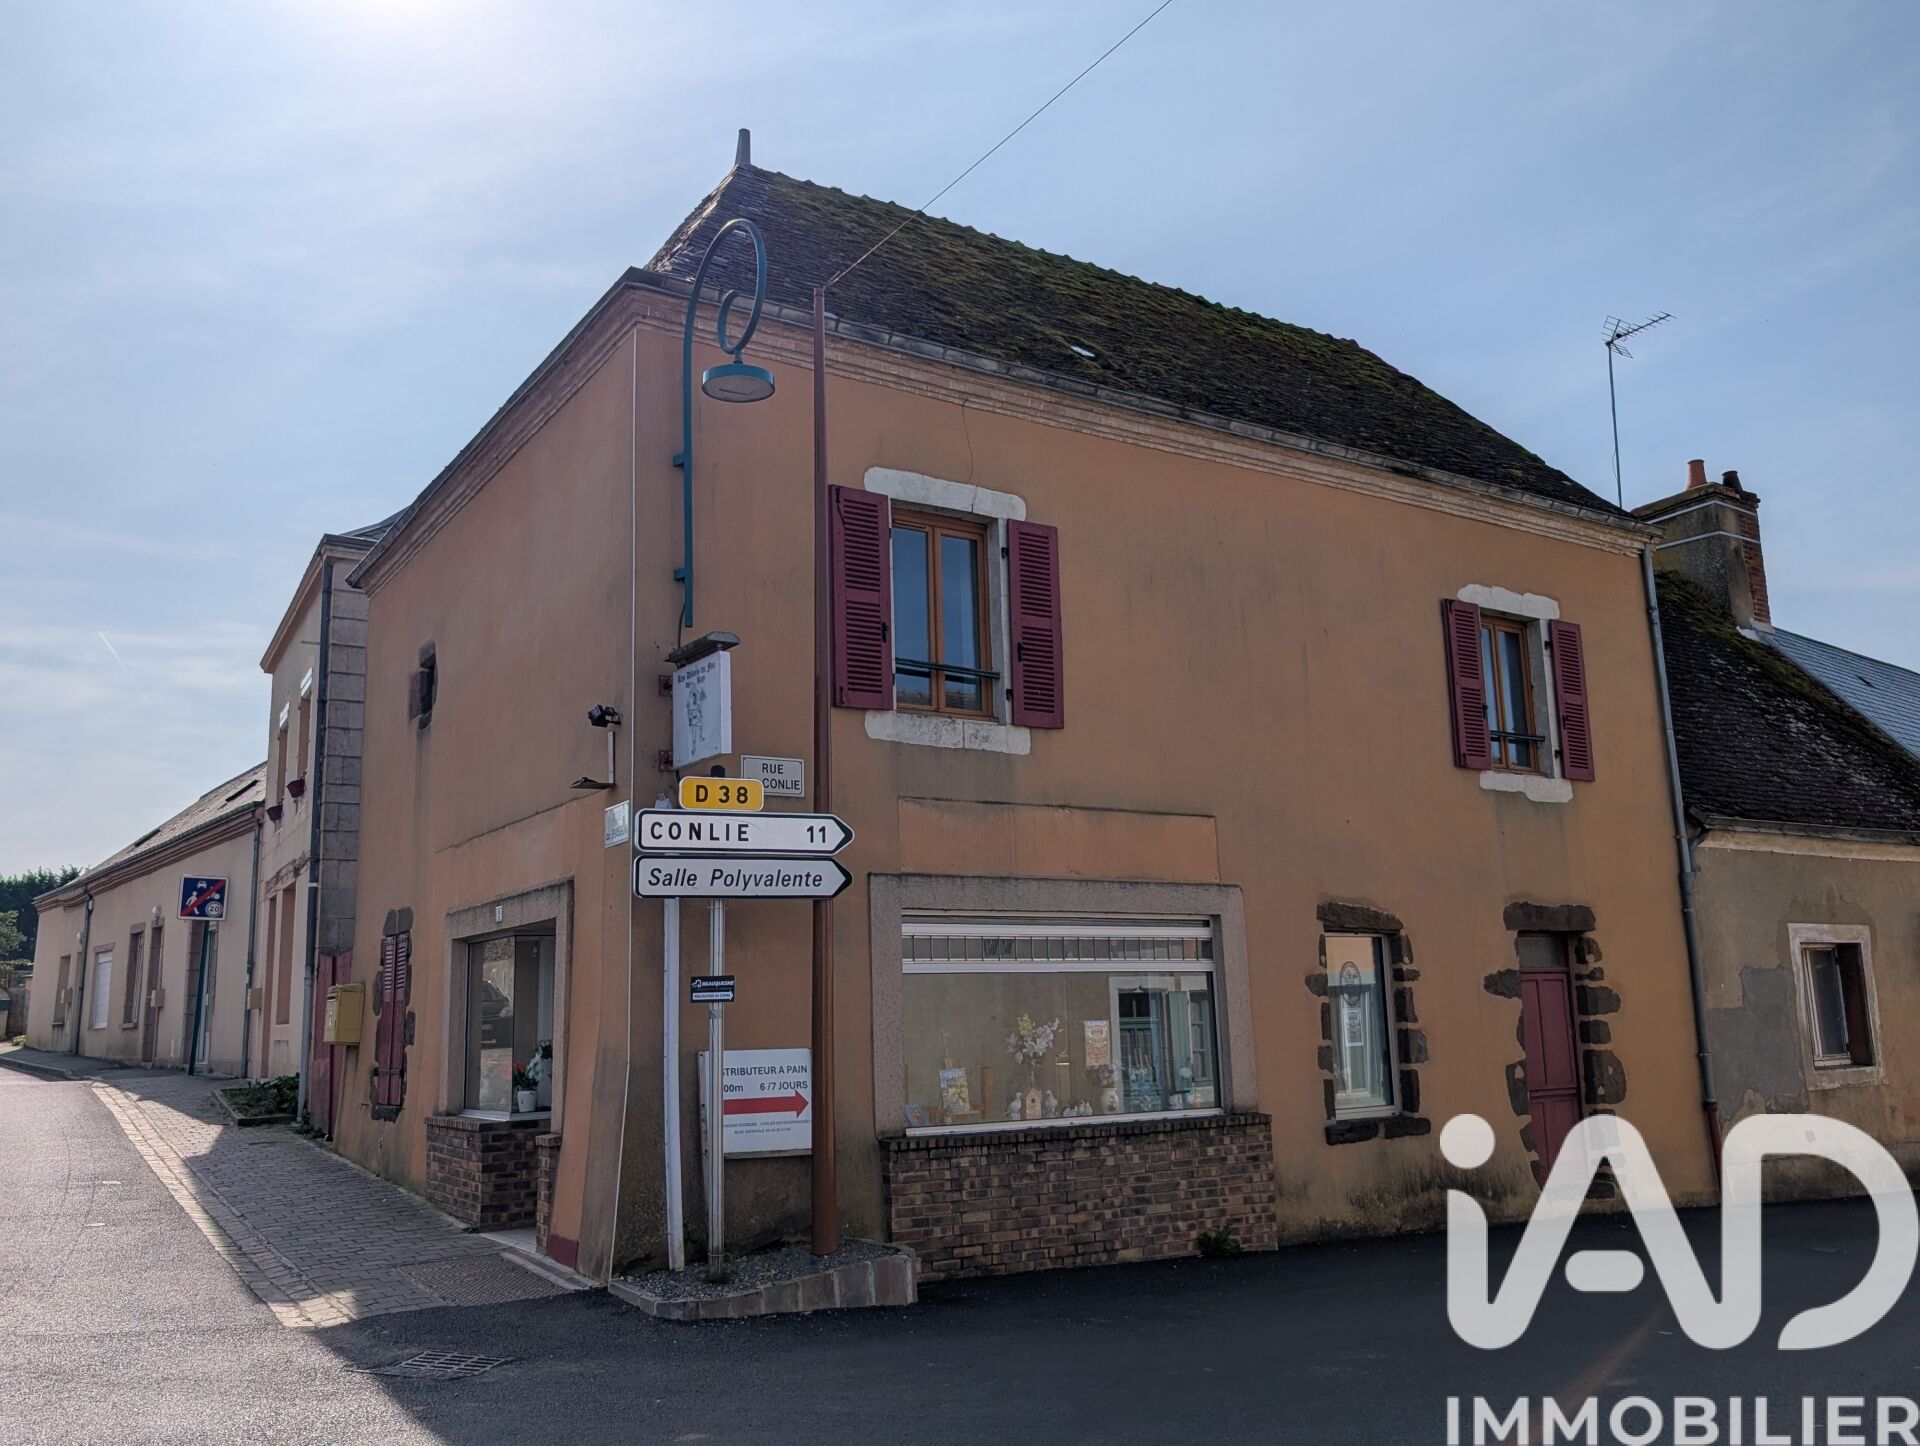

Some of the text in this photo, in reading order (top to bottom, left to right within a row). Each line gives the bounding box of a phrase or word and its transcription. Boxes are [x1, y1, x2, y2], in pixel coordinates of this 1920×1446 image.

[761, 762, 784, 775] RUE
[762, 777, 801, 791] CONLIE
[695, 784, 750, 805] D 38
[650, 821, 750, 843] CONLIE
[806, 825, 828, 844] 11
[648, 867, 823, 891] Salle Polyvalente
[209, 905, 220, 913] 20
[786, 1064, 808, 1074] PAIN
[779, 1080, 808, 1090] JOURS
